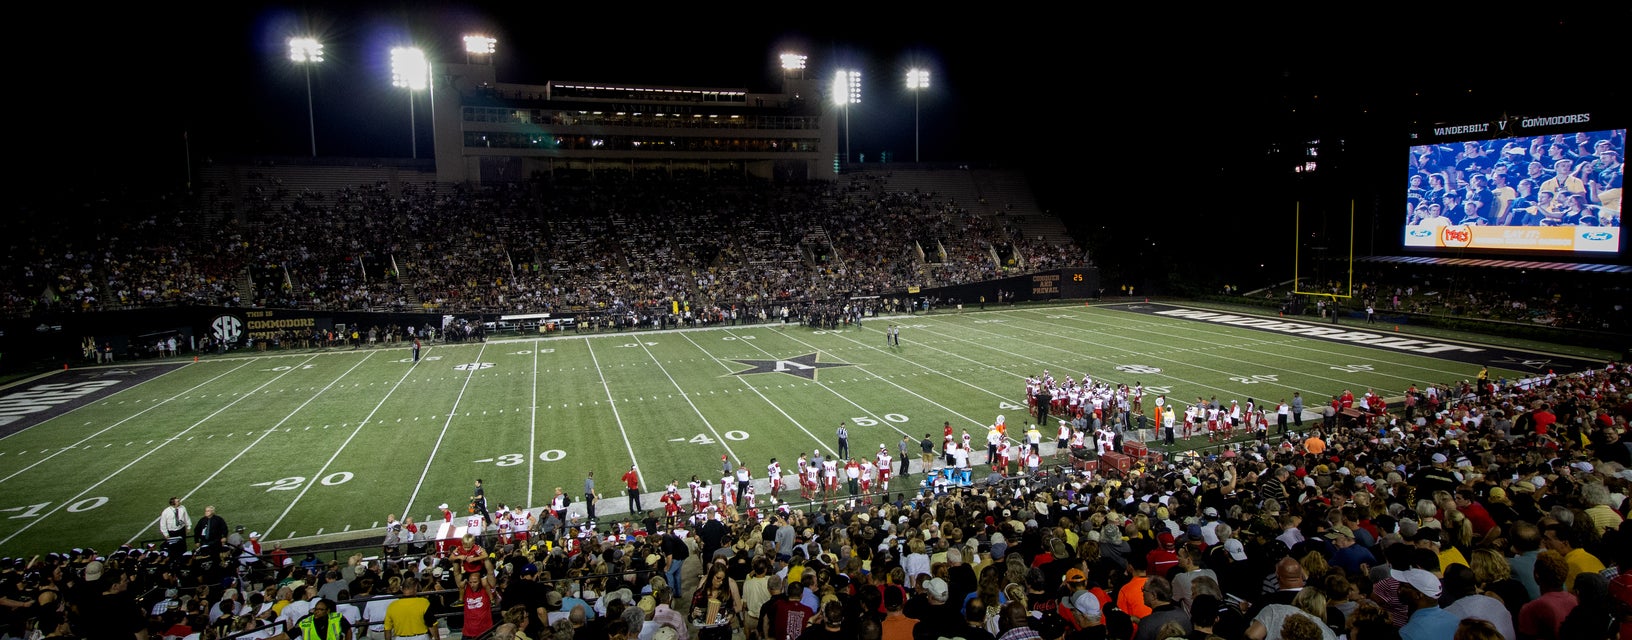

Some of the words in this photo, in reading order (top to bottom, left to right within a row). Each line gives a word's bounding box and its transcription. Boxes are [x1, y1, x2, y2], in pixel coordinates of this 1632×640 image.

[611, 103, 693, 113] VANDERBILT
[1434, 123, 1489, 136] VANDERBILT
[1498, 120, 1507, 131] V
[1521, 113, 1590, 128] COMMODORES
[1073, 273, 1083, 282] 25
[212, 315, 241, 341] SEC
[247, 318, 315, 329] COMMODORE
[1154, 309, 1487, 354] VANDERBILT
[851, 413, 910, 427] 50
[689, 430, 750, 445] 40
[496, 450, 567, 467] 30
[265, 471, 354, 492] 20
[8, 496, 109, 519] 10
[467, 519, 479, 527] 69
[514, 518, 525, 526] 65
